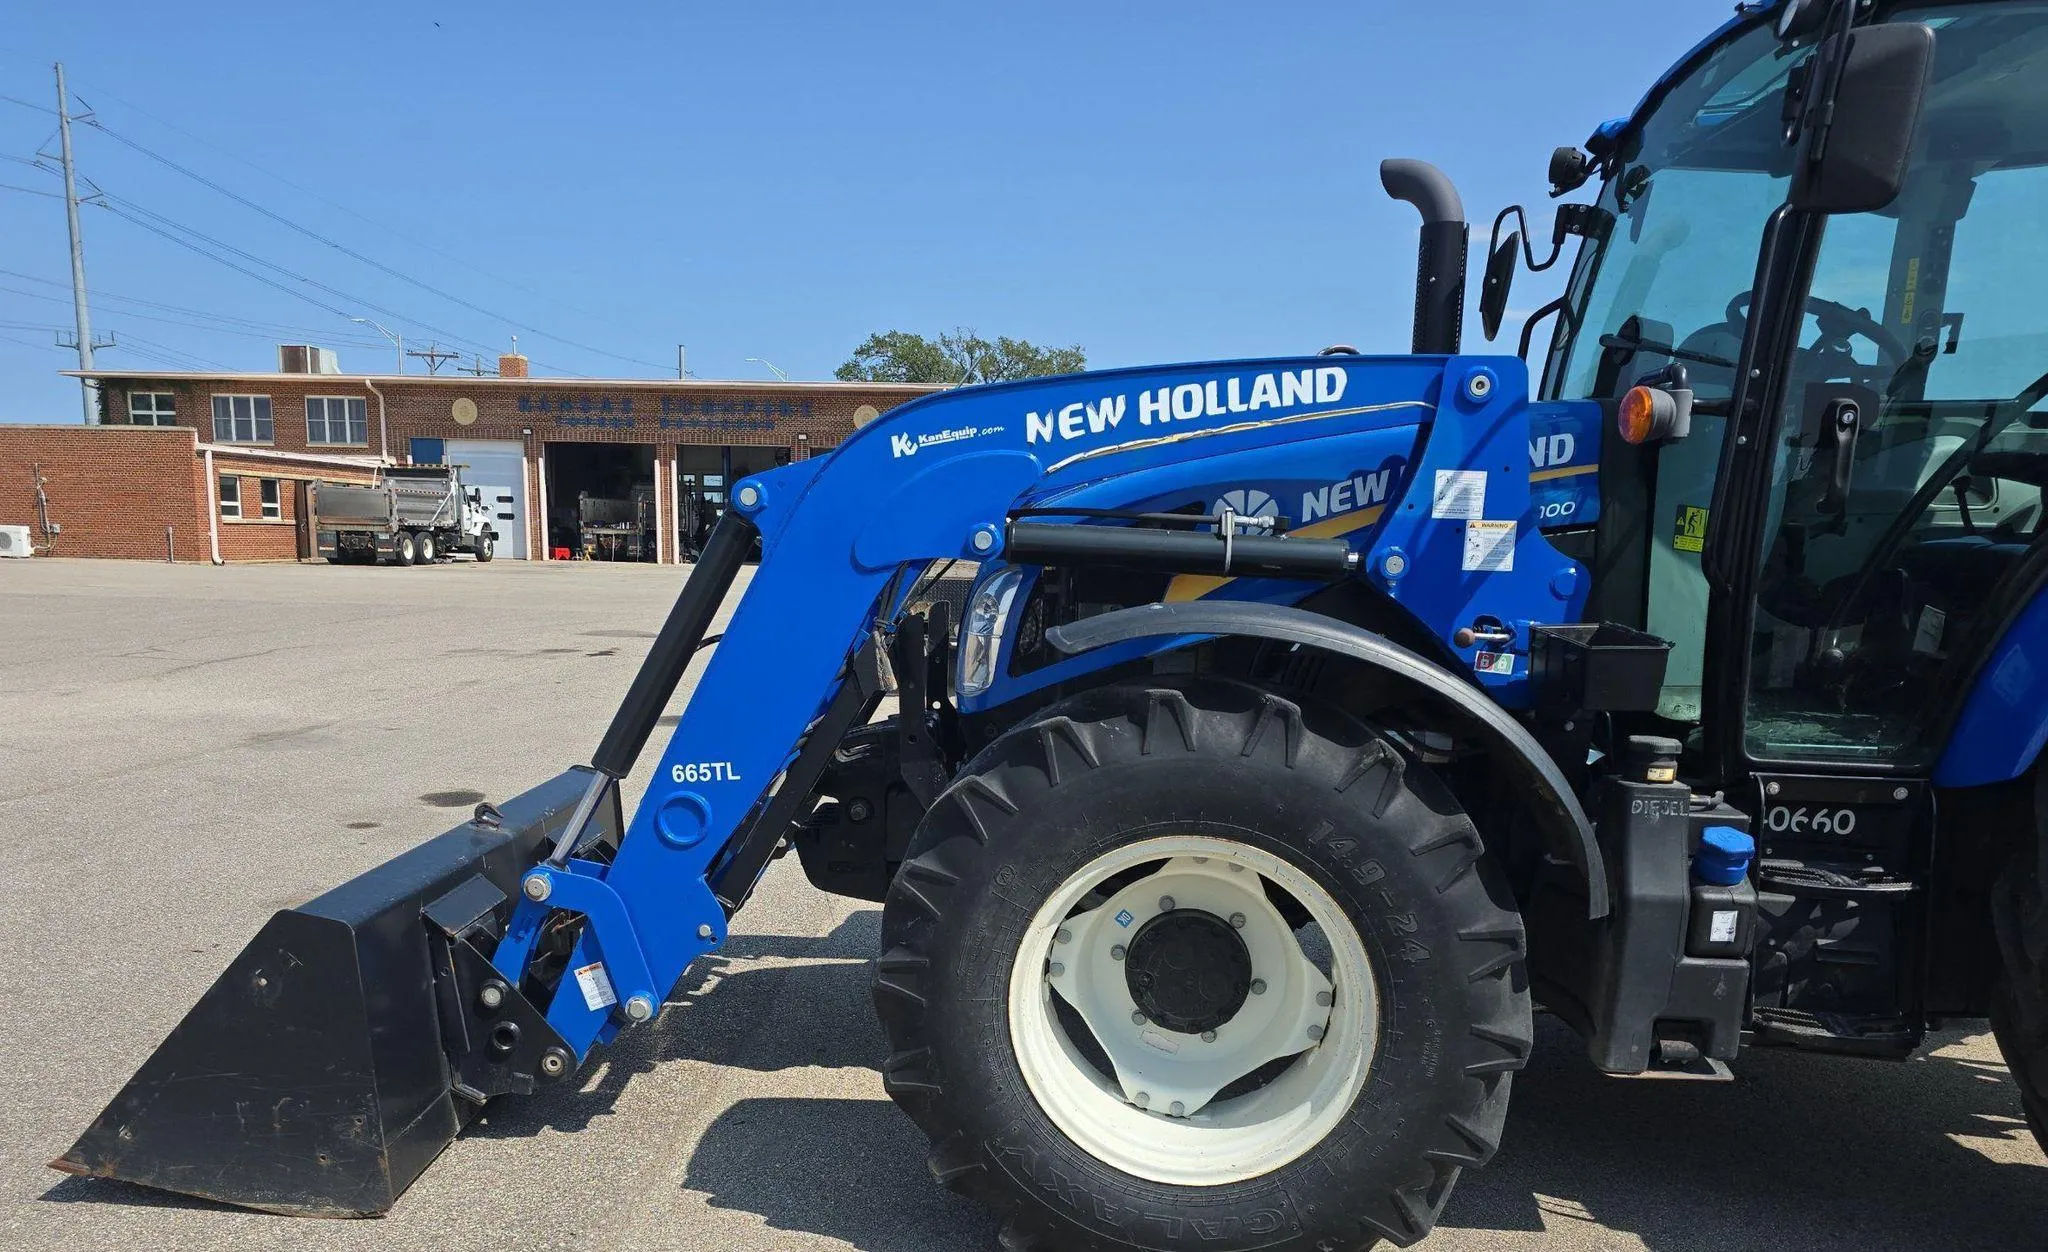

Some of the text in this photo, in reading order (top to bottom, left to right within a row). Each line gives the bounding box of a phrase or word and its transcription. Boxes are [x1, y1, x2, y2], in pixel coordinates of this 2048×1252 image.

[1026, 366, 1348, 445] NEW HOLLAND
[1528, 432, 1575, 468] ND
[1302, 468, 1391, 523] NEW
[672, 761, 741, 783] 665TL
[1631, 799, 1688, 817] DIESEL
[1307, 818, 1432, 963] 14.9-24
